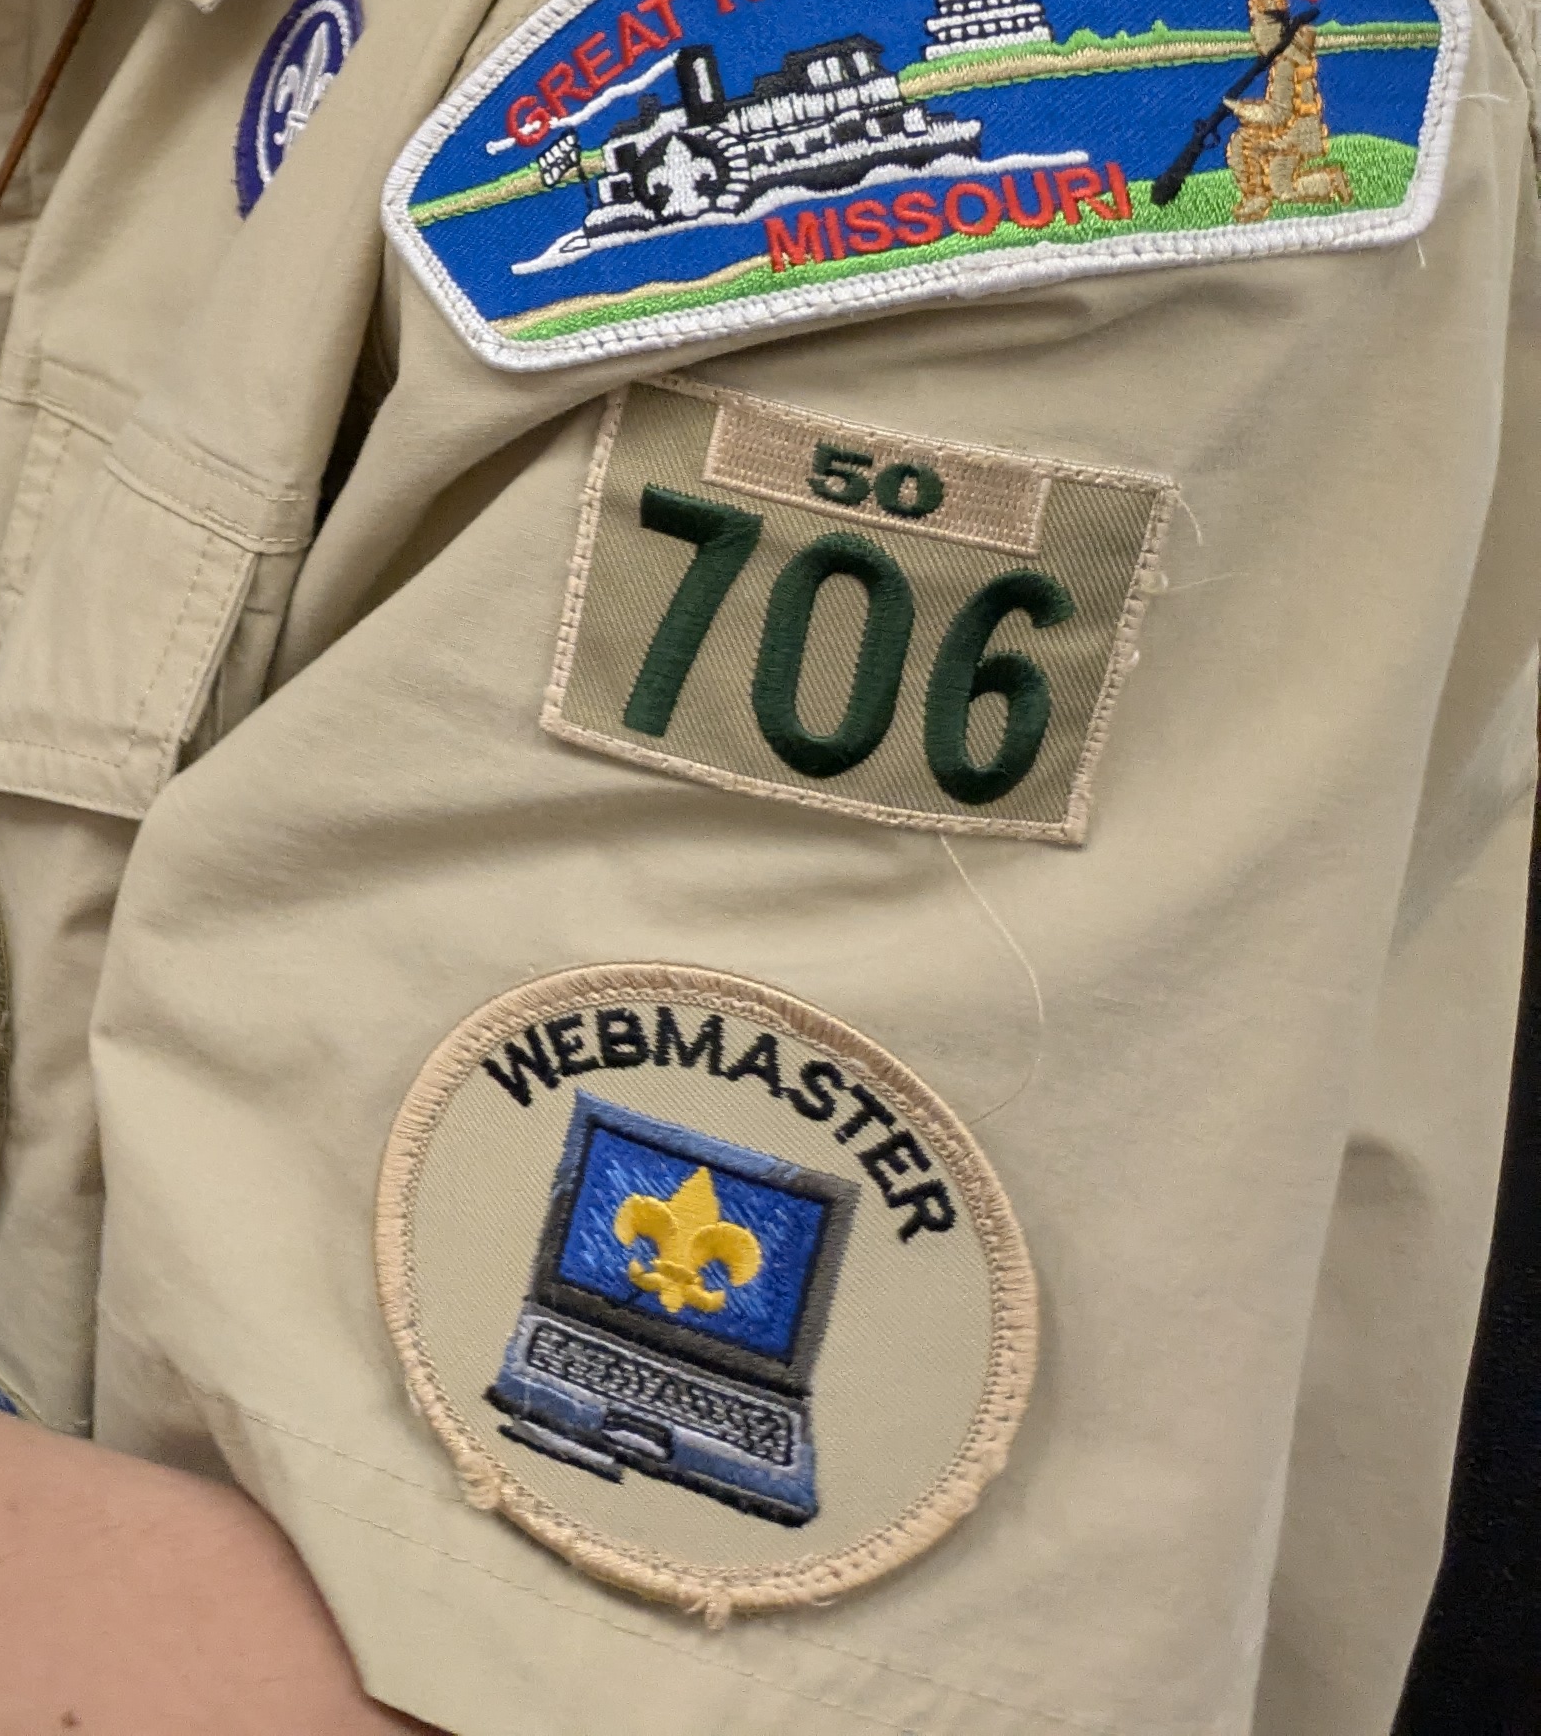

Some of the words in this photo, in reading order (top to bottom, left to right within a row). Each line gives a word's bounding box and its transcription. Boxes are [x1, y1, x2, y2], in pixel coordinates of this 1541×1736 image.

[764, 162, 1132, 272] MISSOURI
[807, 442, 945, 519] 50
[623, 483, 1074, 804] 706
[482, 1006, 956, 1243] WEBMASTER
